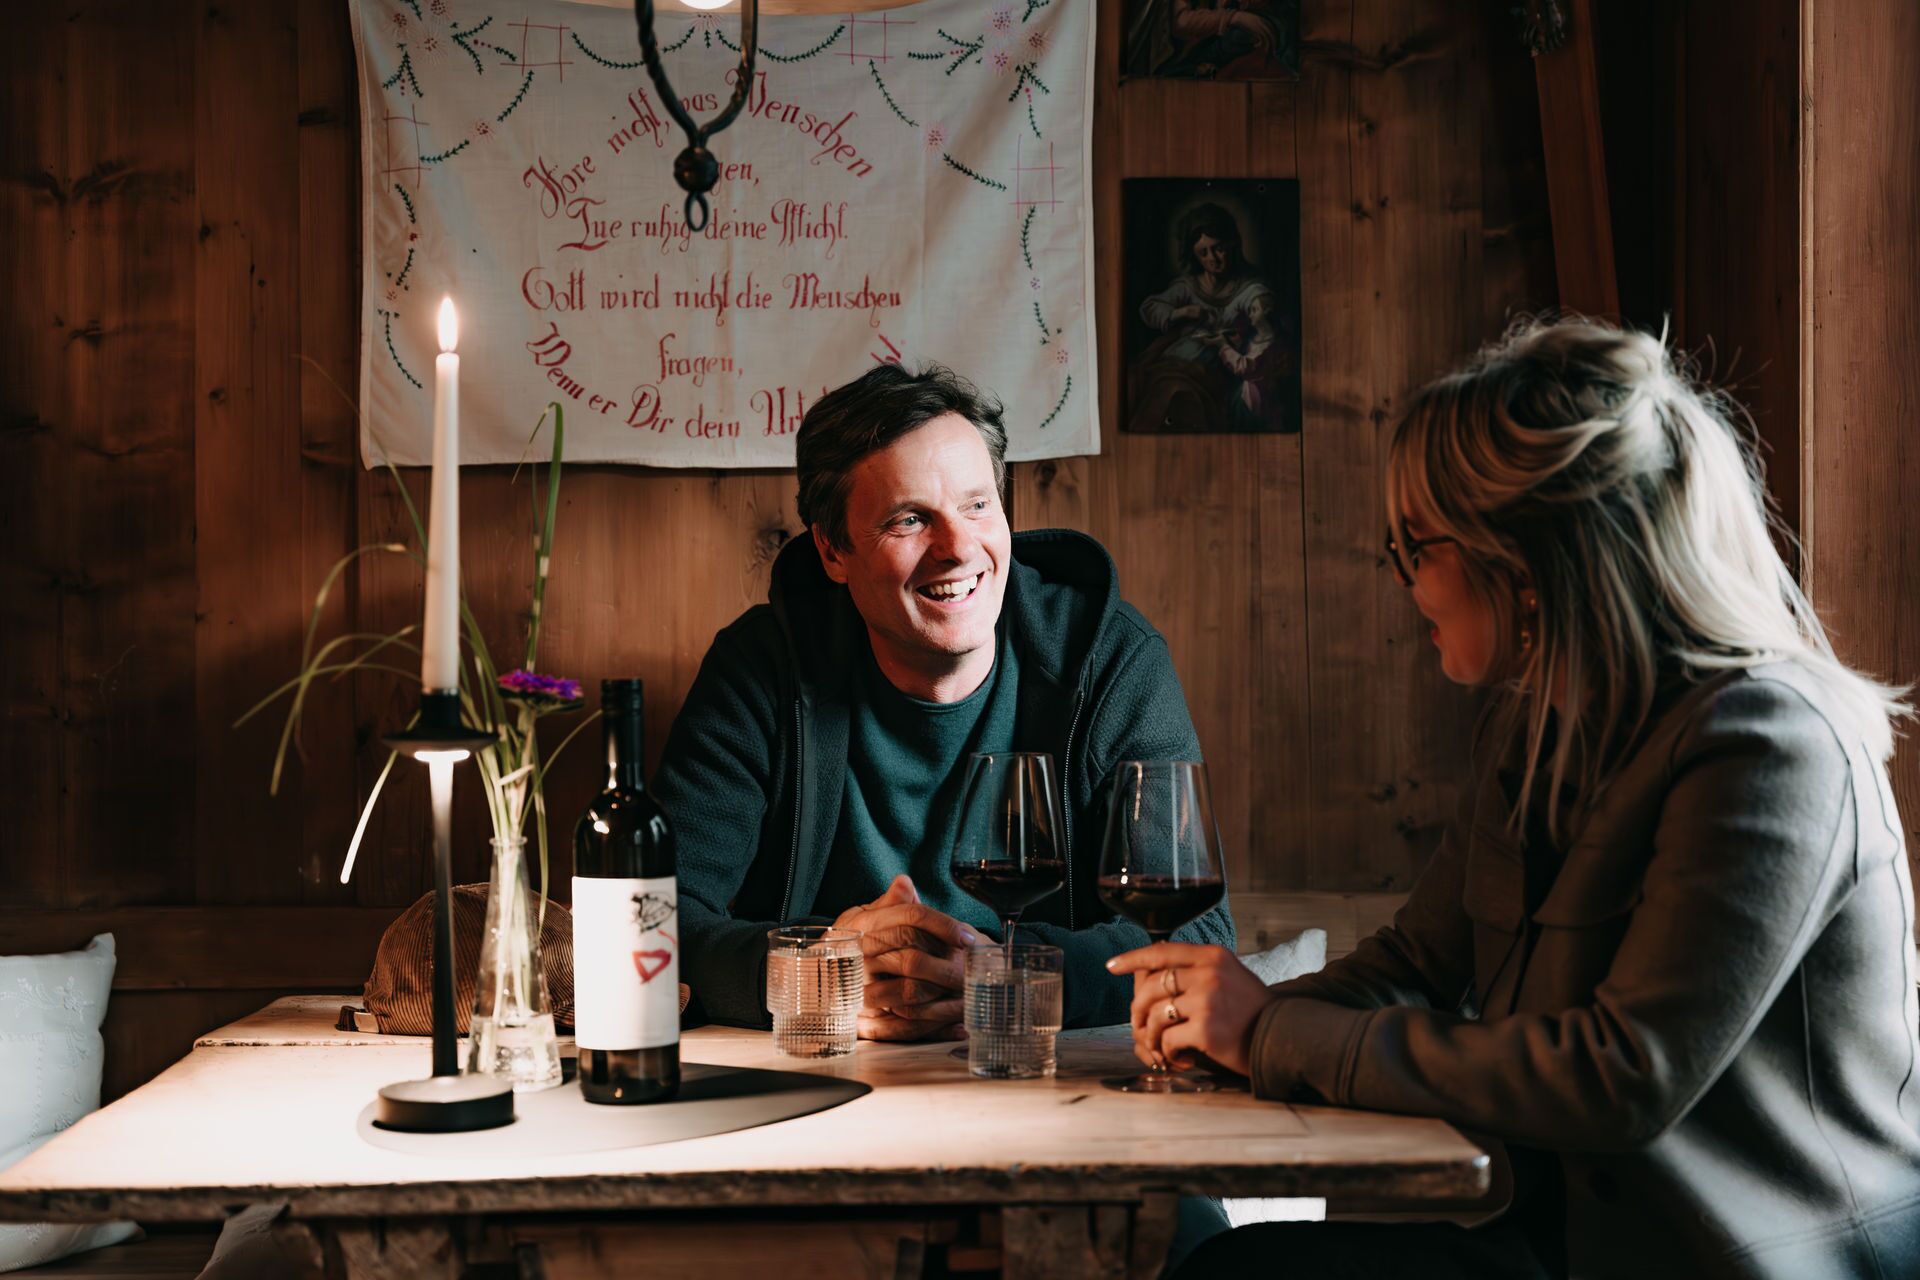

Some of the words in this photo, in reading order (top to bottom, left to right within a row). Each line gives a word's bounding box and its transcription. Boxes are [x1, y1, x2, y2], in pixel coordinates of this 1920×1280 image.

[607, 87, 670, 154] nicht,
[557, 197, 622, 251] Tue
[631, 203, 691, 256] ruhig
[704, 208, 767, 240] deine
[771, 199, 848, 260] Pflicht.
[521, 267, 586, 312] Gott
[600, 273, 660, 310] wird
[673, 269, 730, 327] nicht
[736, 272, 773, 309] die
[782, 272, 902, 328] Menschen
[526, 321, 585, 399] Wenn
[588, 394, 617, 414] er
[625, 384, 674, 443] Dir
[685, 403, 740, 439] dein
[656, 333, 743, 388] fragen,
